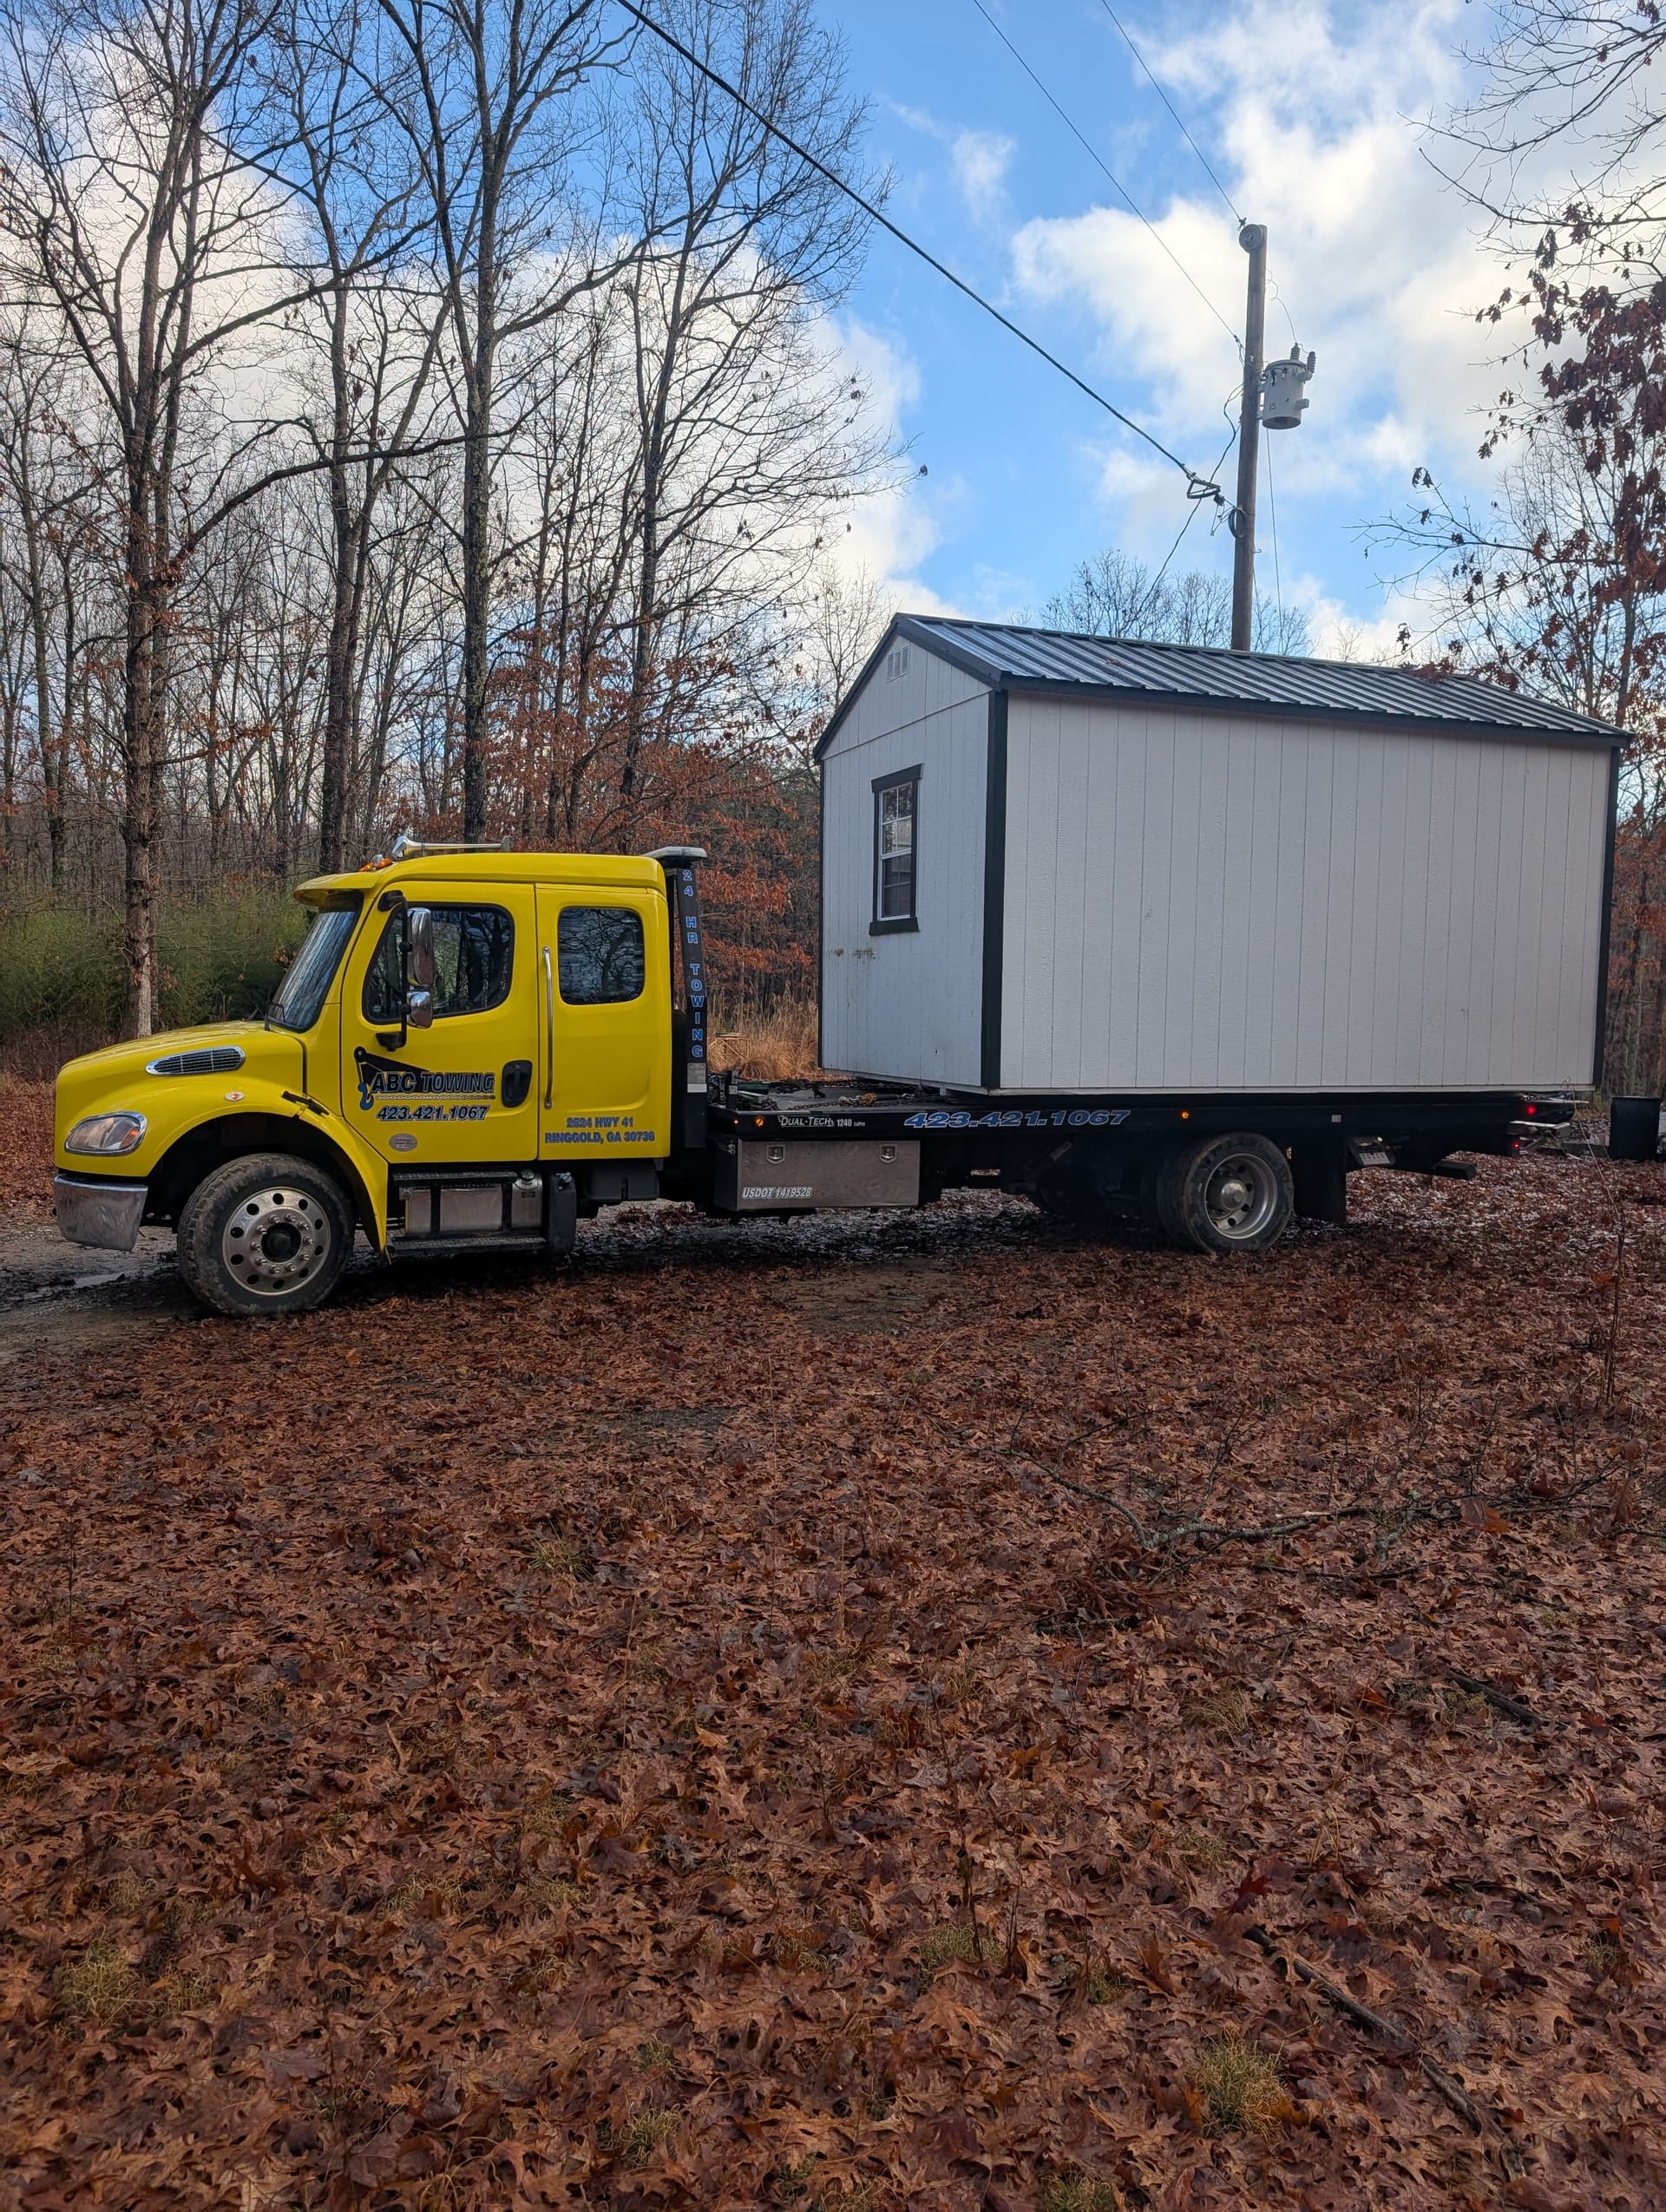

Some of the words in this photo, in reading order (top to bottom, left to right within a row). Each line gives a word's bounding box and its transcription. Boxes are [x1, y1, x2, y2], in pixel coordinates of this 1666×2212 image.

[683, 869, 694, 897] 24
[685, 916, 699, 944] HR
[690, 963, 705, 1057] TOWING
[372, 1072, 416, 1093] ABC
[421, 1072, 495, 1093] TOWING
[376, 1104, 490, 1121] 423.421.1067
[903, 1110, 1131, 1128] 423.421.1067
[594, 1116, 620, 1128] HWY
[621, 1116, 633, 1127] 41
[836, 1118, 852, 1127] 1240
[545, 1131, 604, 1144] RINGGOLD,
[606, 1131, 622, 1142] GA
[623, 1131, 655, 1142] 30736
[742, 1187, 774, 1199] USDOT
[774, 1186, 813, 1199] 1419528
